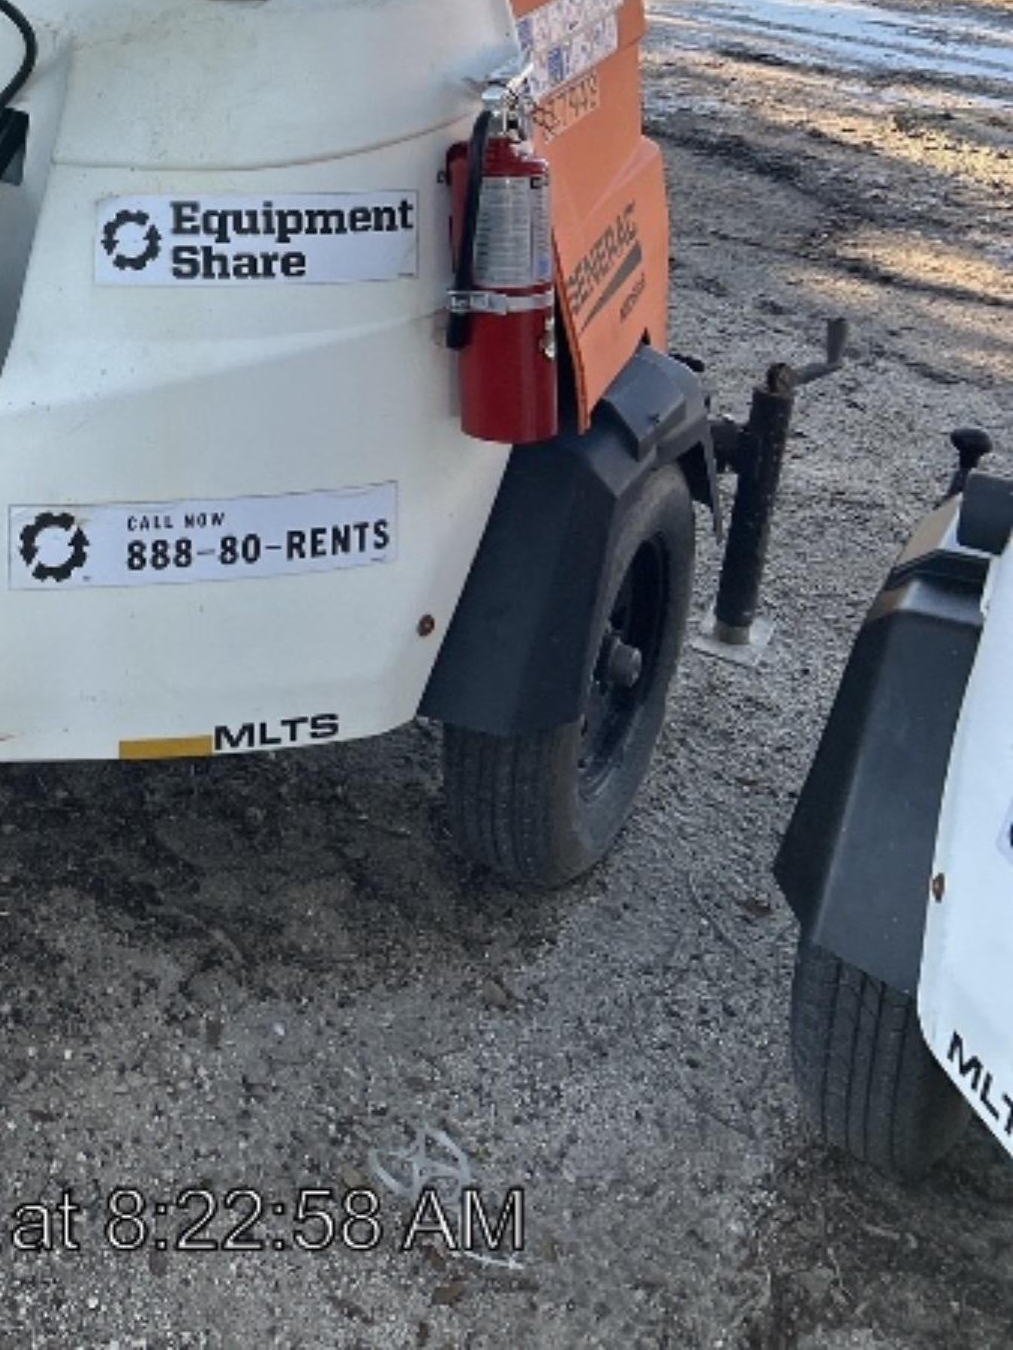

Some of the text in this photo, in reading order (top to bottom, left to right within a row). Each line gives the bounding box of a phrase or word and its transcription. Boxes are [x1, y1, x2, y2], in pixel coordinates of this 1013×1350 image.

[170, 199, 414, 244] Equipment
[171, 245, 307, 279] Share
[126, 511, 226, 531] CALL NOW
[214, 713, 340, 751] MLTS
